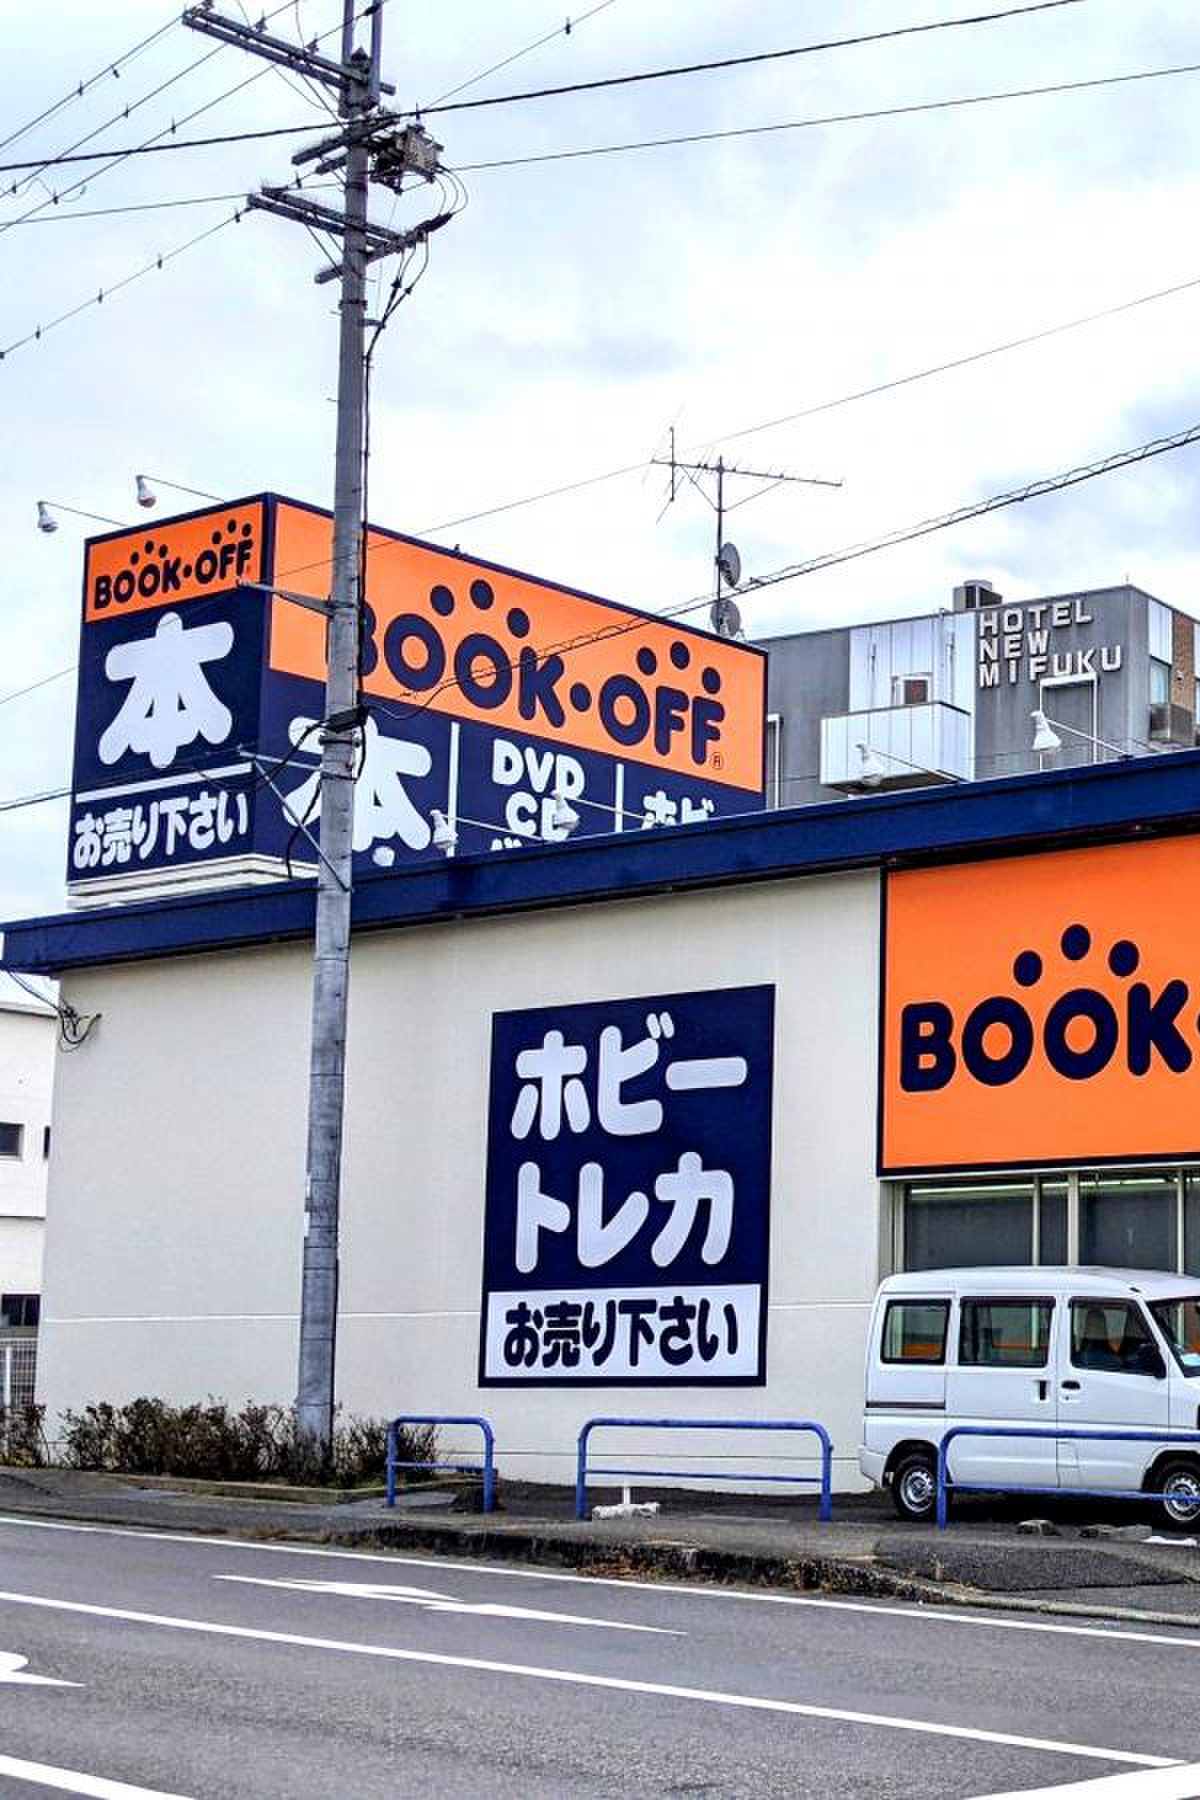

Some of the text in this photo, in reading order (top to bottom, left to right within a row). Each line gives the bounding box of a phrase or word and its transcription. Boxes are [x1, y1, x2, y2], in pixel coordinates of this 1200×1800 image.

[979, 600, 1093, 637] HOTEL
[979, 630, 1049, 662] NEW
[98, 611, 234, 768] 本
[979, 645, 1122, 688] MIFUKU
[492, 738, 585, 800] DVD
[73, 790, 249, 869] お売り下さい
[511, 1011, 748, 1141] ホビー
[515, 1151, 734, 1274] トレカ
[504, 1296, 738, 1368] お売り下さい
